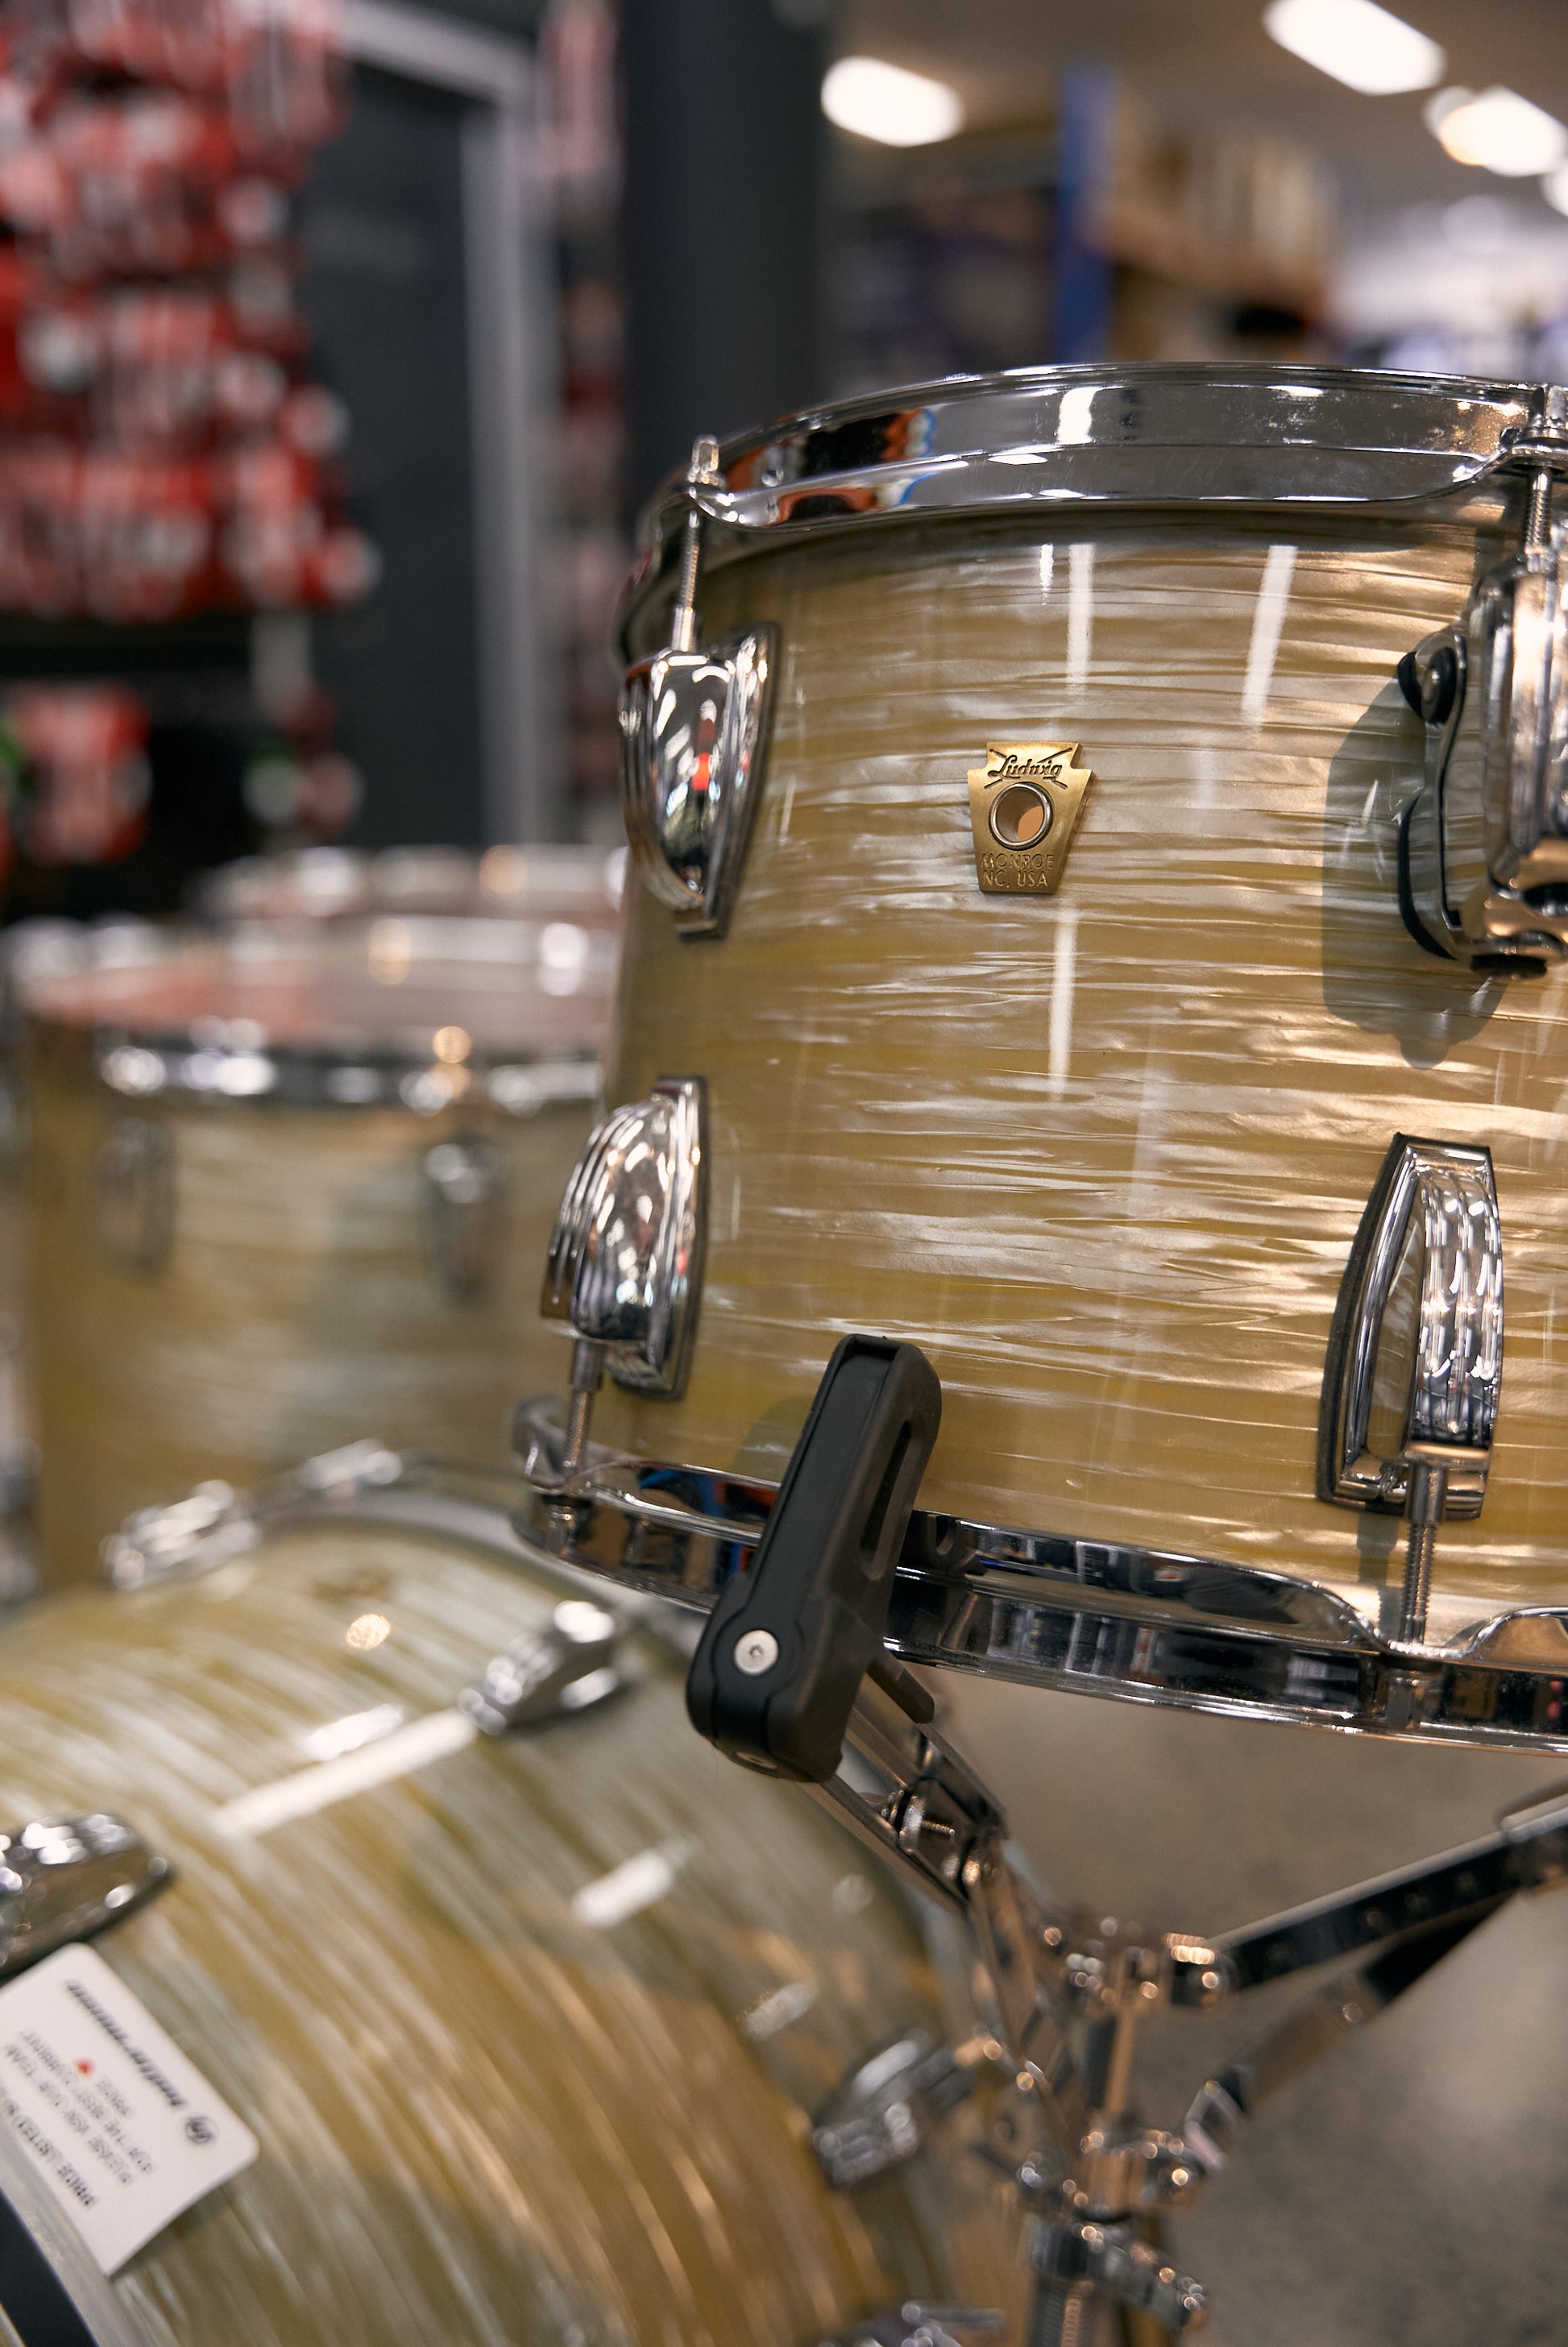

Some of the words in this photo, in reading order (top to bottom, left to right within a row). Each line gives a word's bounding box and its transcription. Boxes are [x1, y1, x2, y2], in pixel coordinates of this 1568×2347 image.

[988, 754, 1063, 778] Ludwig
[980, 853, 1055, 869] MONROE
[1018, 870, 1047, 887] USA
